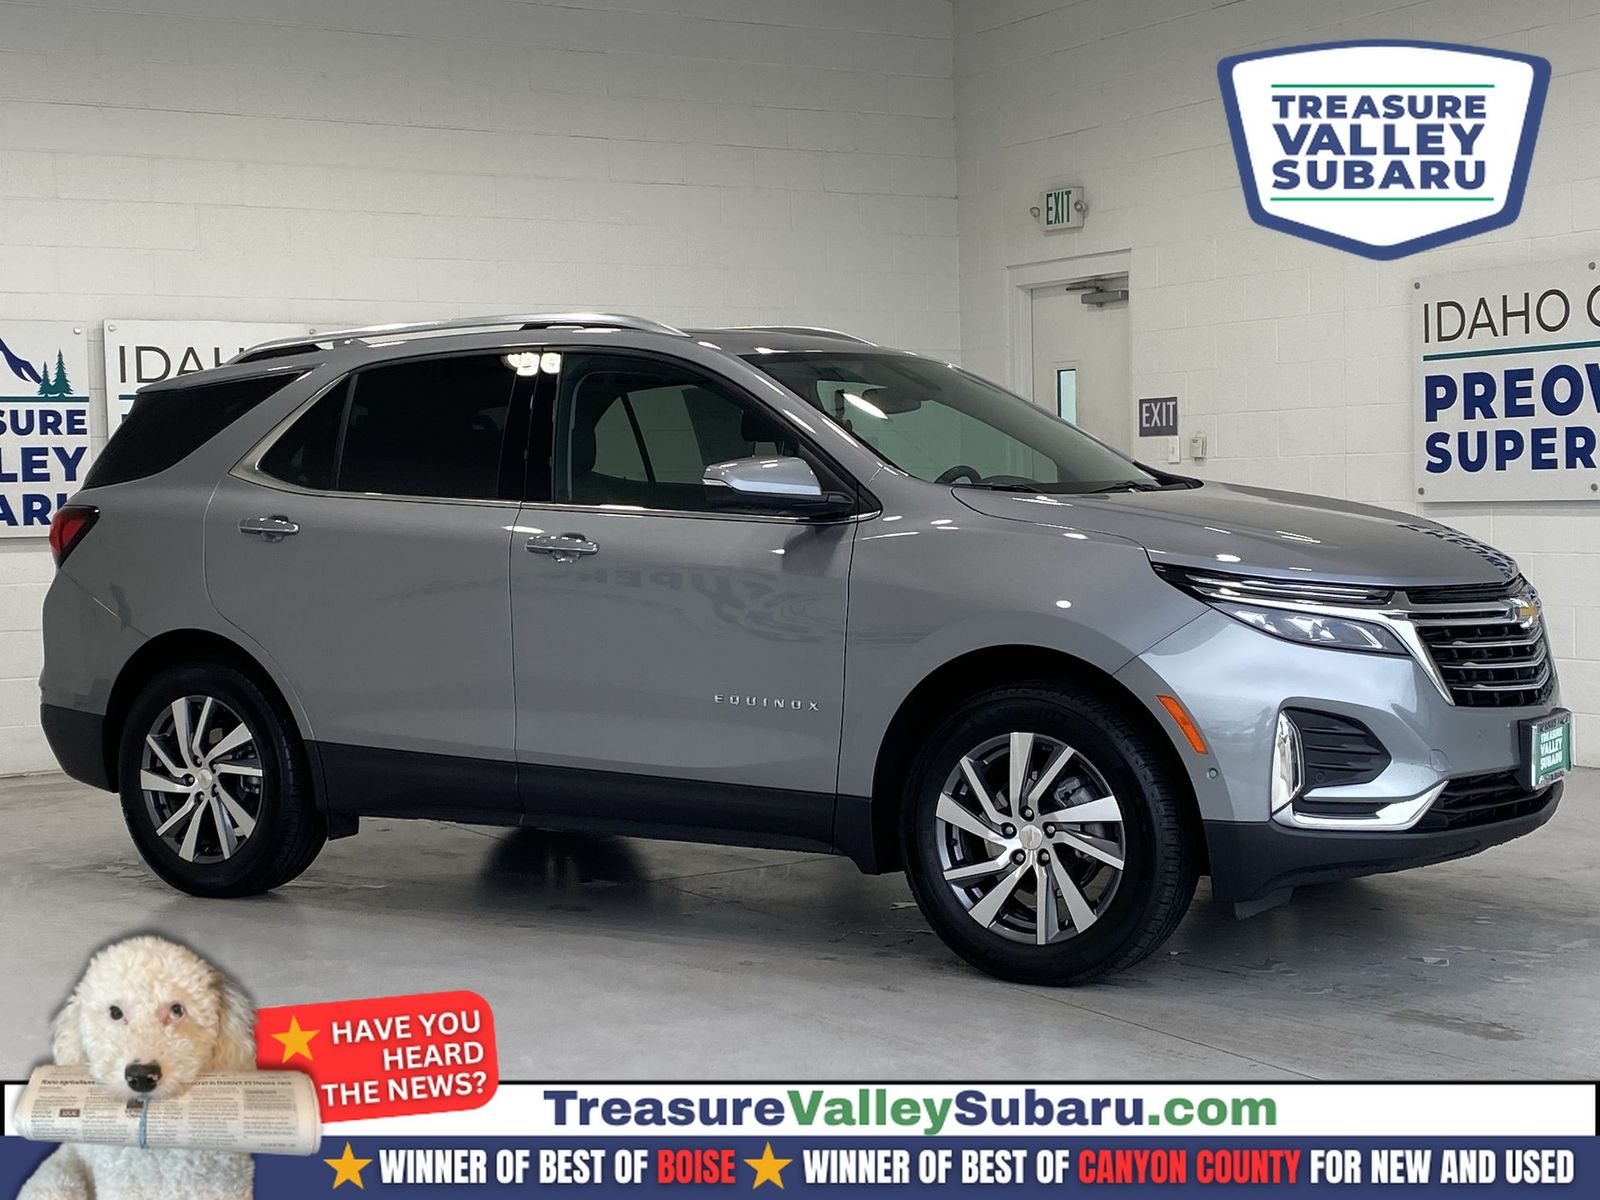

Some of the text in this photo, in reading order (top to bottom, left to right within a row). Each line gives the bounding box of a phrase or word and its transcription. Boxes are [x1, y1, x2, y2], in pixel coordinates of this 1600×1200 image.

[1046, 190, 1072, 225] EXIT
[1424, 289, 1570, 343] IDAHO
[1425, 363, 1600, 423] PREO
[1142, 401, 1176, 428] EXIT
[1425, 426, 1597, 473] SUPER
[714, 694, 819, 711] EQUINOX
[1540, 738, 1563, 757] VALLEY
